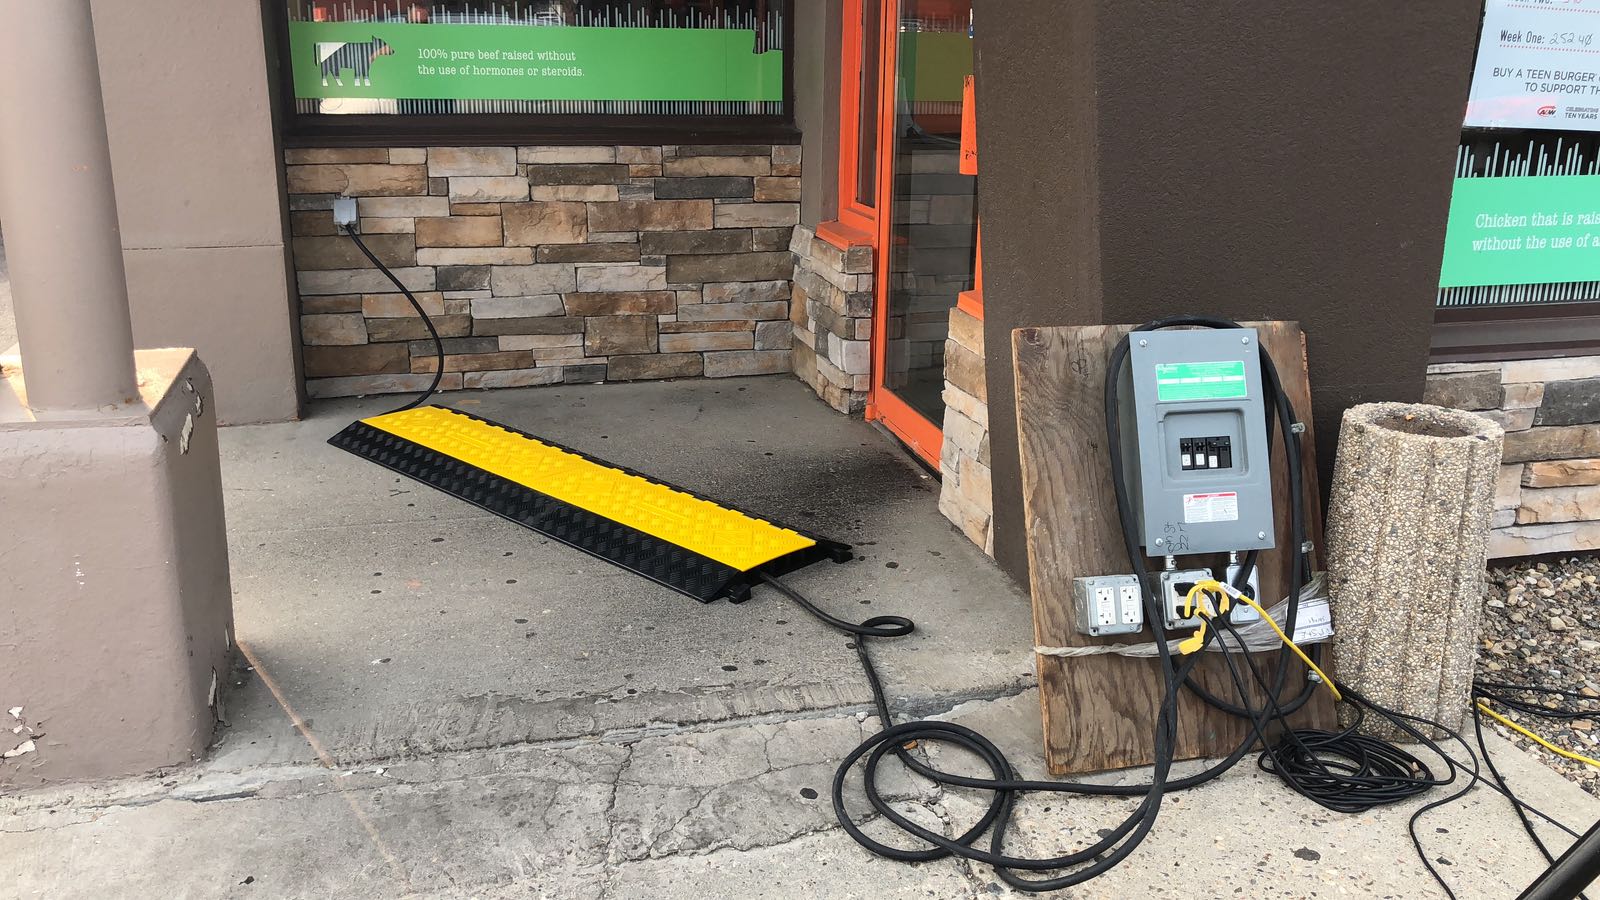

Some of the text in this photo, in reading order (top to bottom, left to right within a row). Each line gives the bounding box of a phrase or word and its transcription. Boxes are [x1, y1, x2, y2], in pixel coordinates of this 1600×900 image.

[1500, 29, 1545, 44] Week One:
[418, 48, 577, 61] 100% pure beef raised without
[417, 65, 585, 77] the use of hormones or steroids.
[1493, 67, 1595, 82] BUY A TEEN BURGER
[1524, 82, 1538, 92] TO
[1540, 83, 1587, 95] SUPPORT
[1578, 112, 1598, 120] YEARS
[1475, 213, 1527, 228] Chicken
[1531, 212, 1558, 226] that
[1561, 211, 1573, 225] is
[1472, 236, 1521, 251] without
[1526, 235, 1546, 249] the
[1551, 236, 1572, 249] use
[1576, 232, 1591, 248] of
